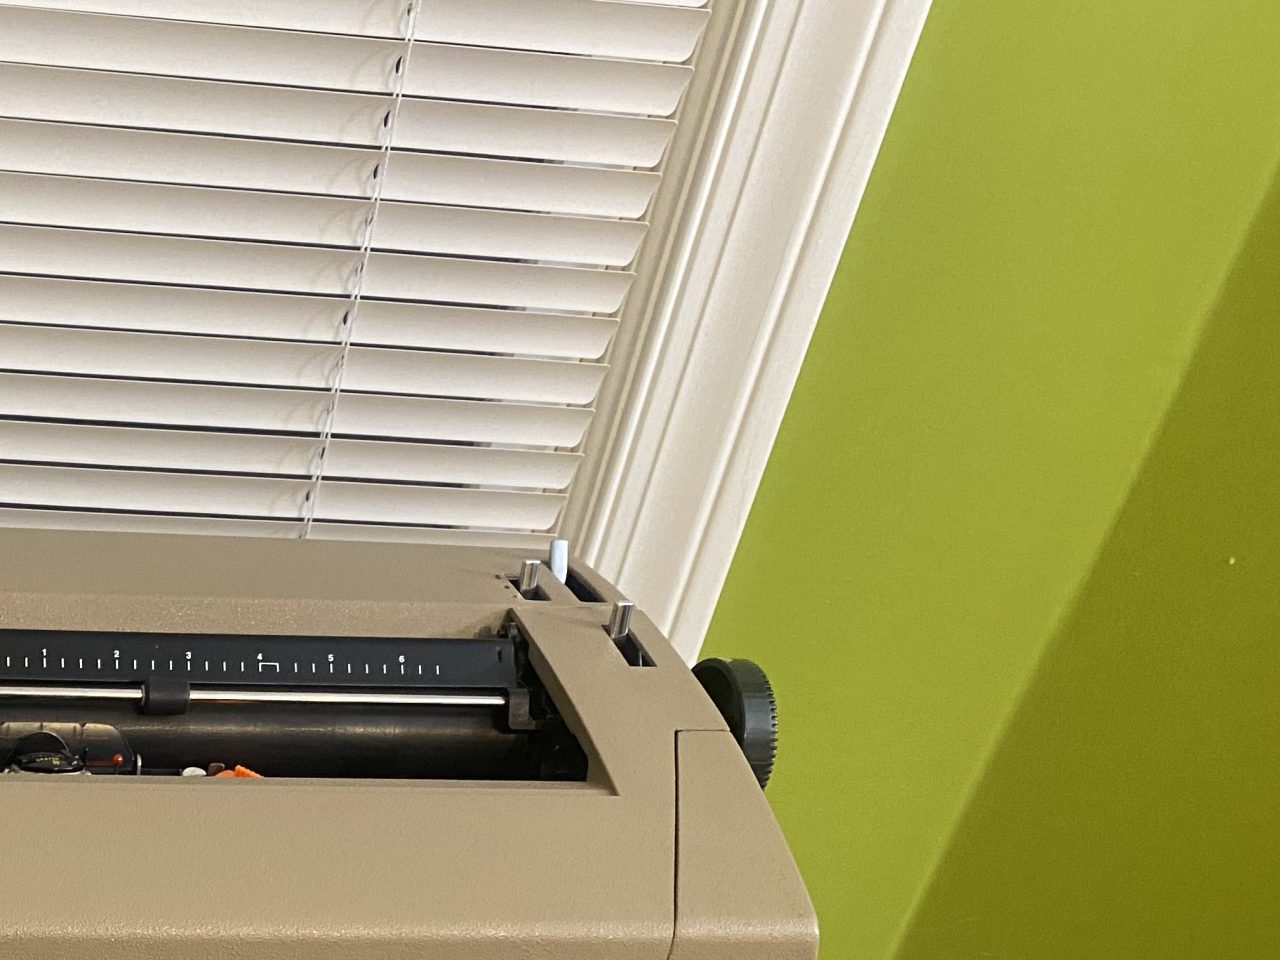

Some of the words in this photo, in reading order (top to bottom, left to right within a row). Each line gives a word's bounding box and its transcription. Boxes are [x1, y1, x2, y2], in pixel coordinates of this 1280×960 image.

[41, 649, 47, 657] 1
[113, 650, 120, 658] 2
[185, 652, 192, 660] 3
[256, 653, 263, 661] 4
[327, 654, 334, 662] 5
